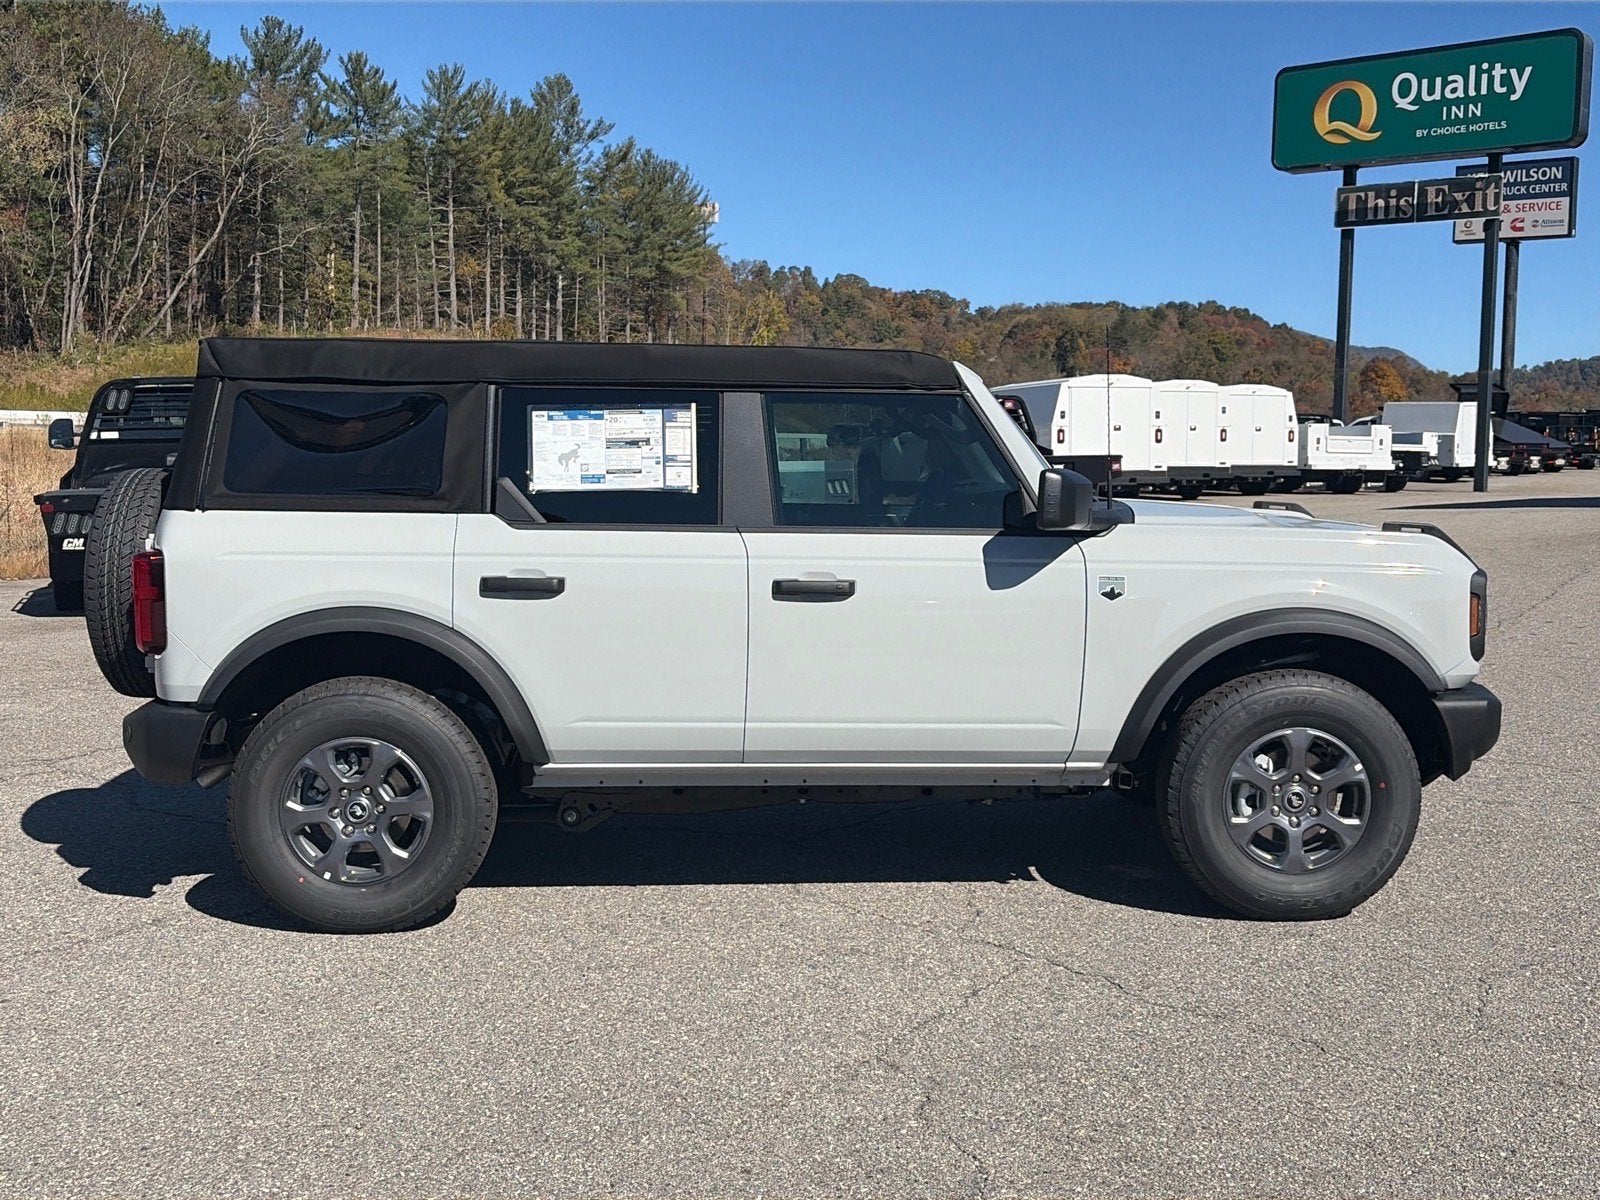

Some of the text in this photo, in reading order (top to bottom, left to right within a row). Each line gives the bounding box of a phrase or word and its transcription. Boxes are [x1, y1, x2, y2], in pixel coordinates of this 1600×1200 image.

[1391, 62, 1533, 111] Quality
[1442, 102, 1482, 121] INN
[1415, 120, 1507, 138] BY CHOICE HOTELS
[1502, 166, 1563, 183] WILSON
[1502, 182, 1569, 196] RUCK CENTER
[1340, 181, 1500, 222] This Exit
[1515, 200, 1562, 213] SERVICE
